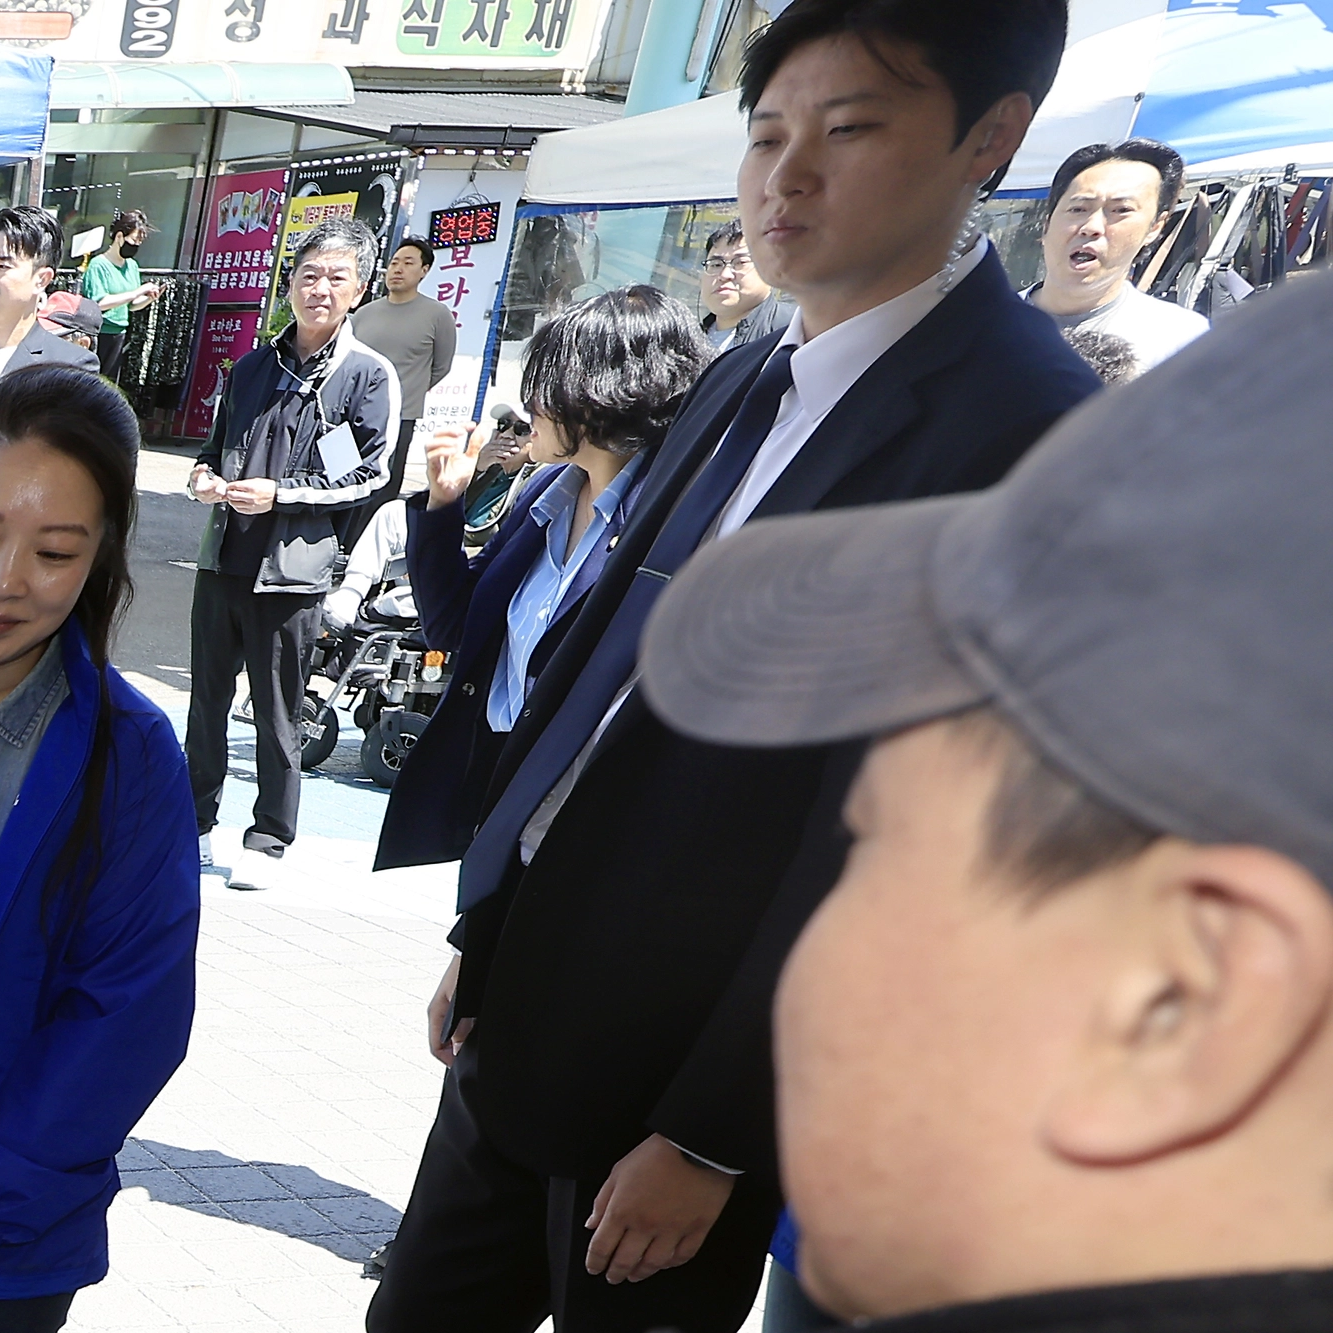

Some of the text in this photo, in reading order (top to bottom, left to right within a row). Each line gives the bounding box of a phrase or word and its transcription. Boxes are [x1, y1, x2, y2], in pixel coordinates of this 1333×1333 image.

[128, 0, 173, 51] 92
[402, 0, 573, 49] 식자재
[440, 211, 492, 242] 영업중
[429, 383, 468, 395] arot
[427, 406, 471, 417] 예약문의
